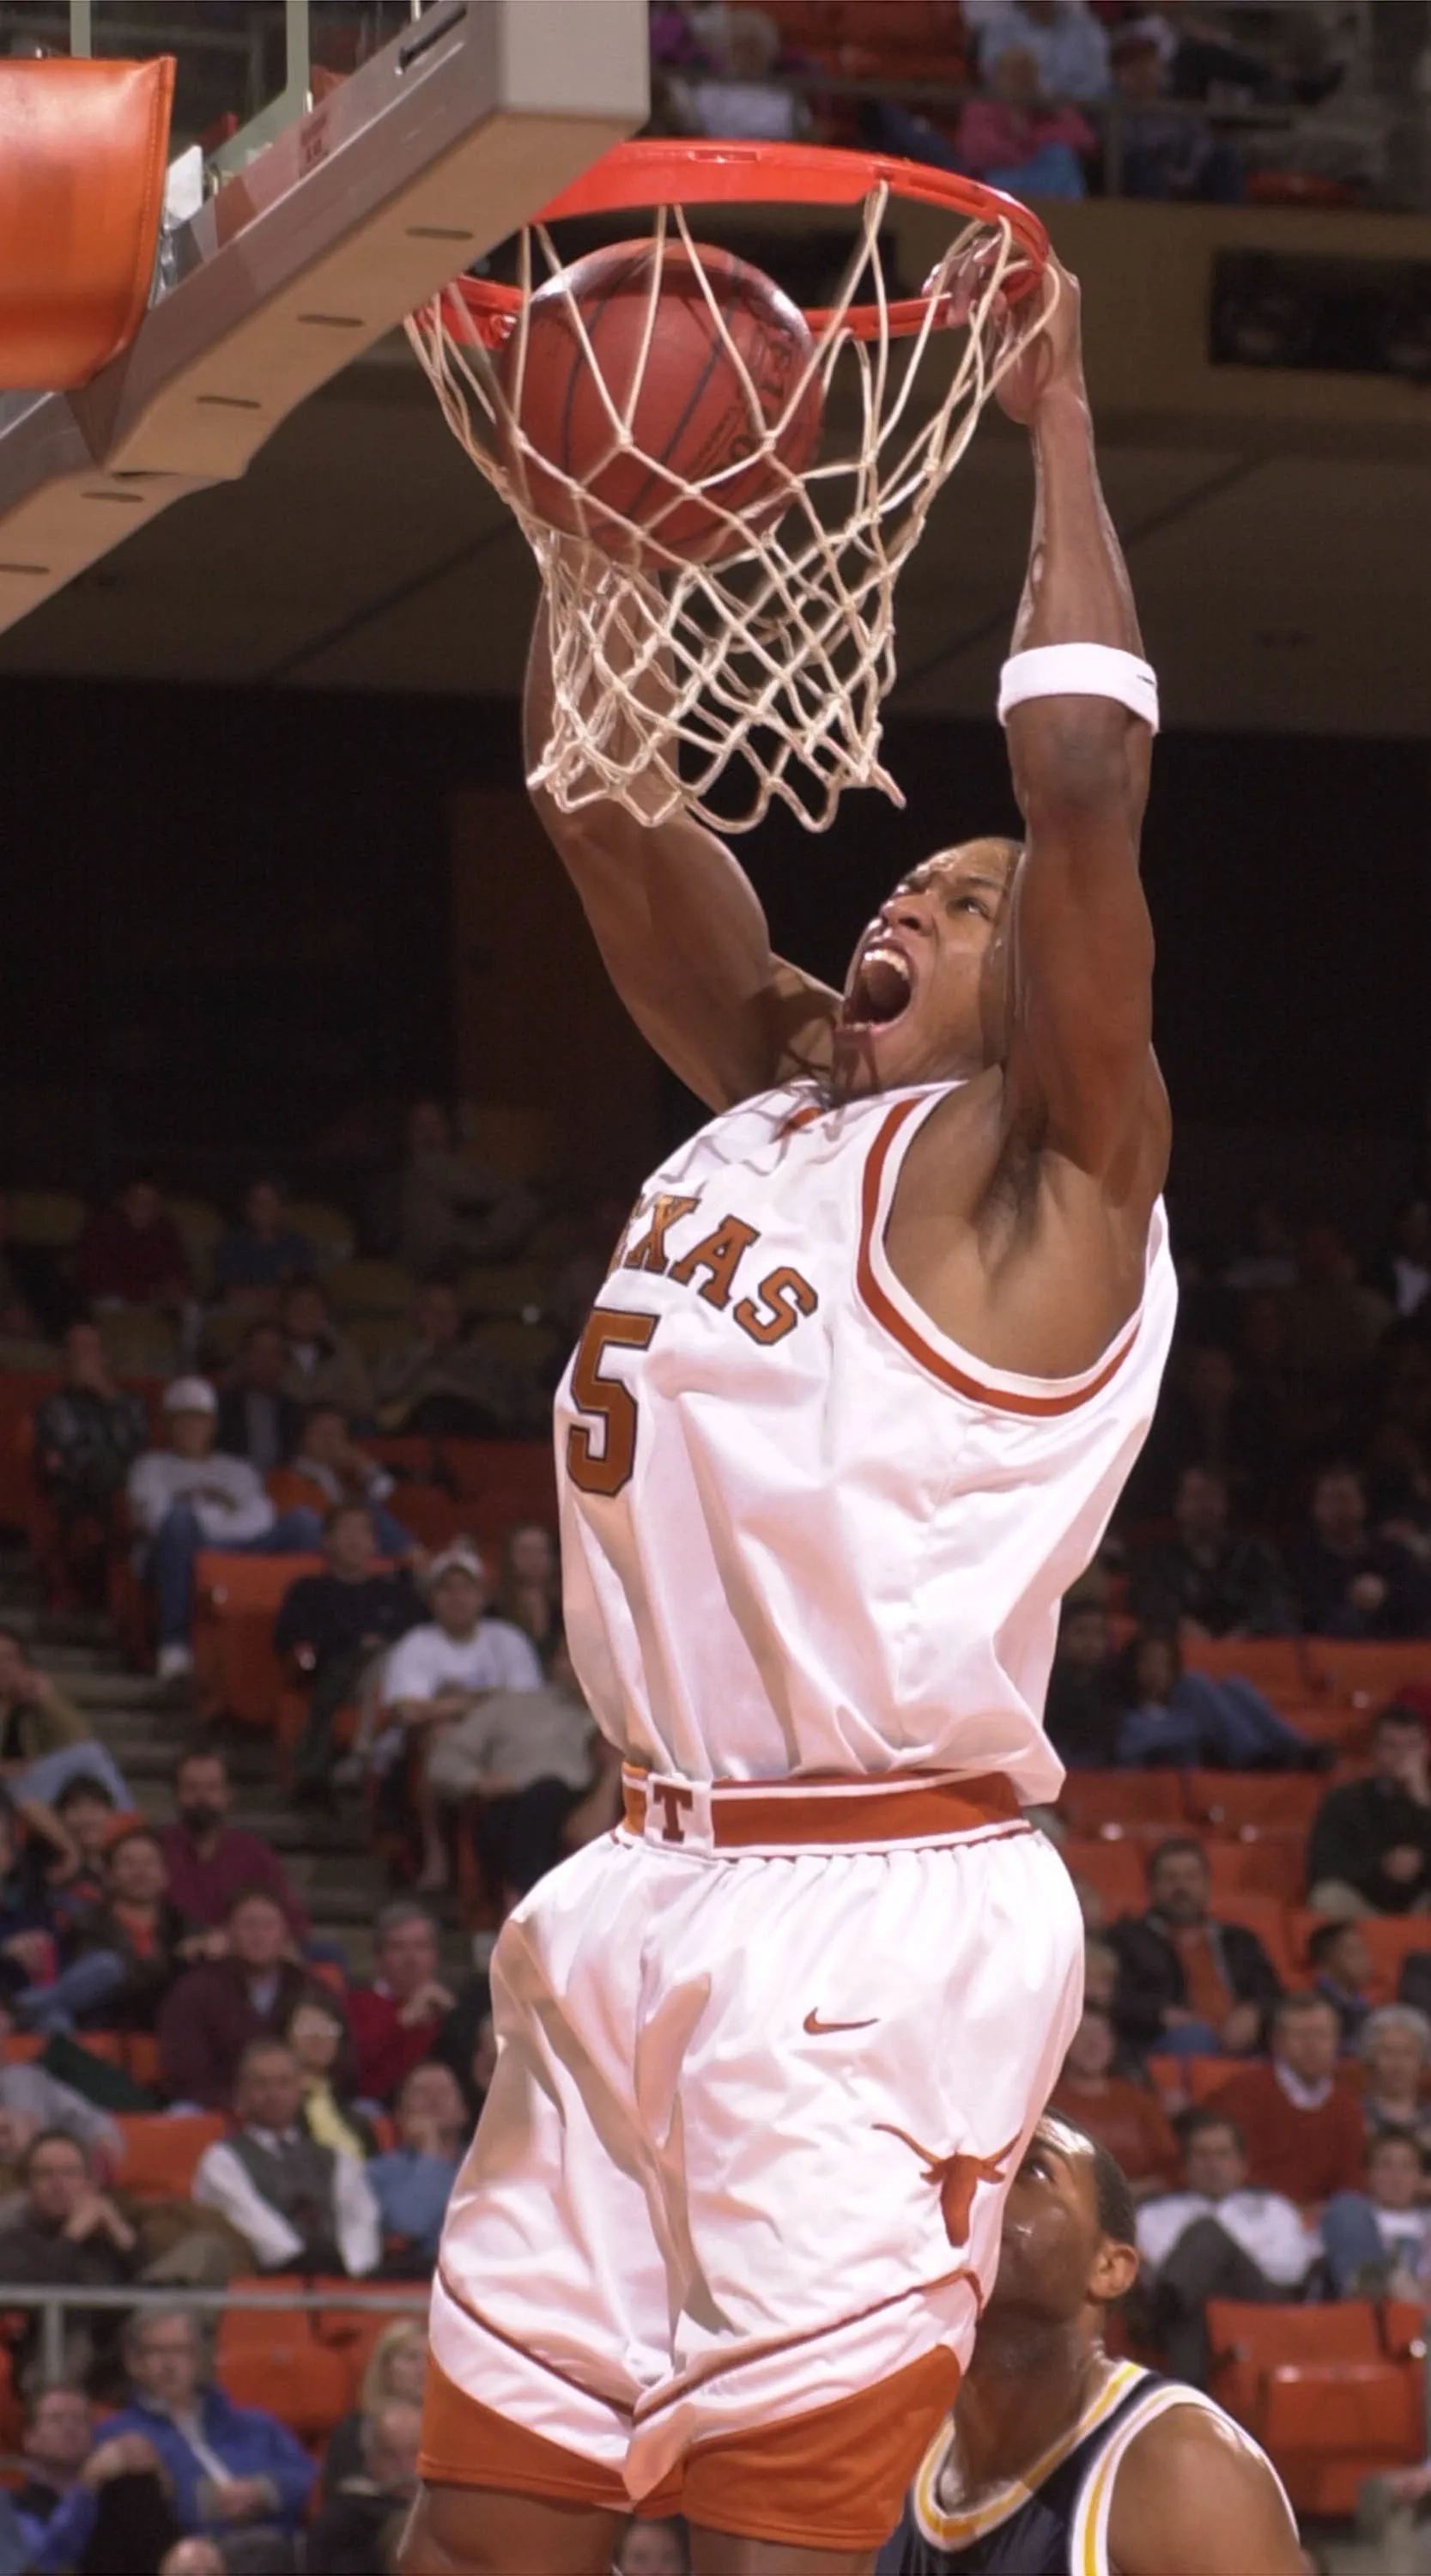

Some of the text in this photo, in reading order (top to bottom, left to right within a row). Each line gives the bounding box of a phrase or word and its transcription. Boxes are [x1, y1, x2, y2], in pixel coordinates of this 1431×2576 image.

[608, 1194, 819, 1346] XAS
[567, 1306, 662, 1498] 5
[653, 1783, 694, 1844] T
